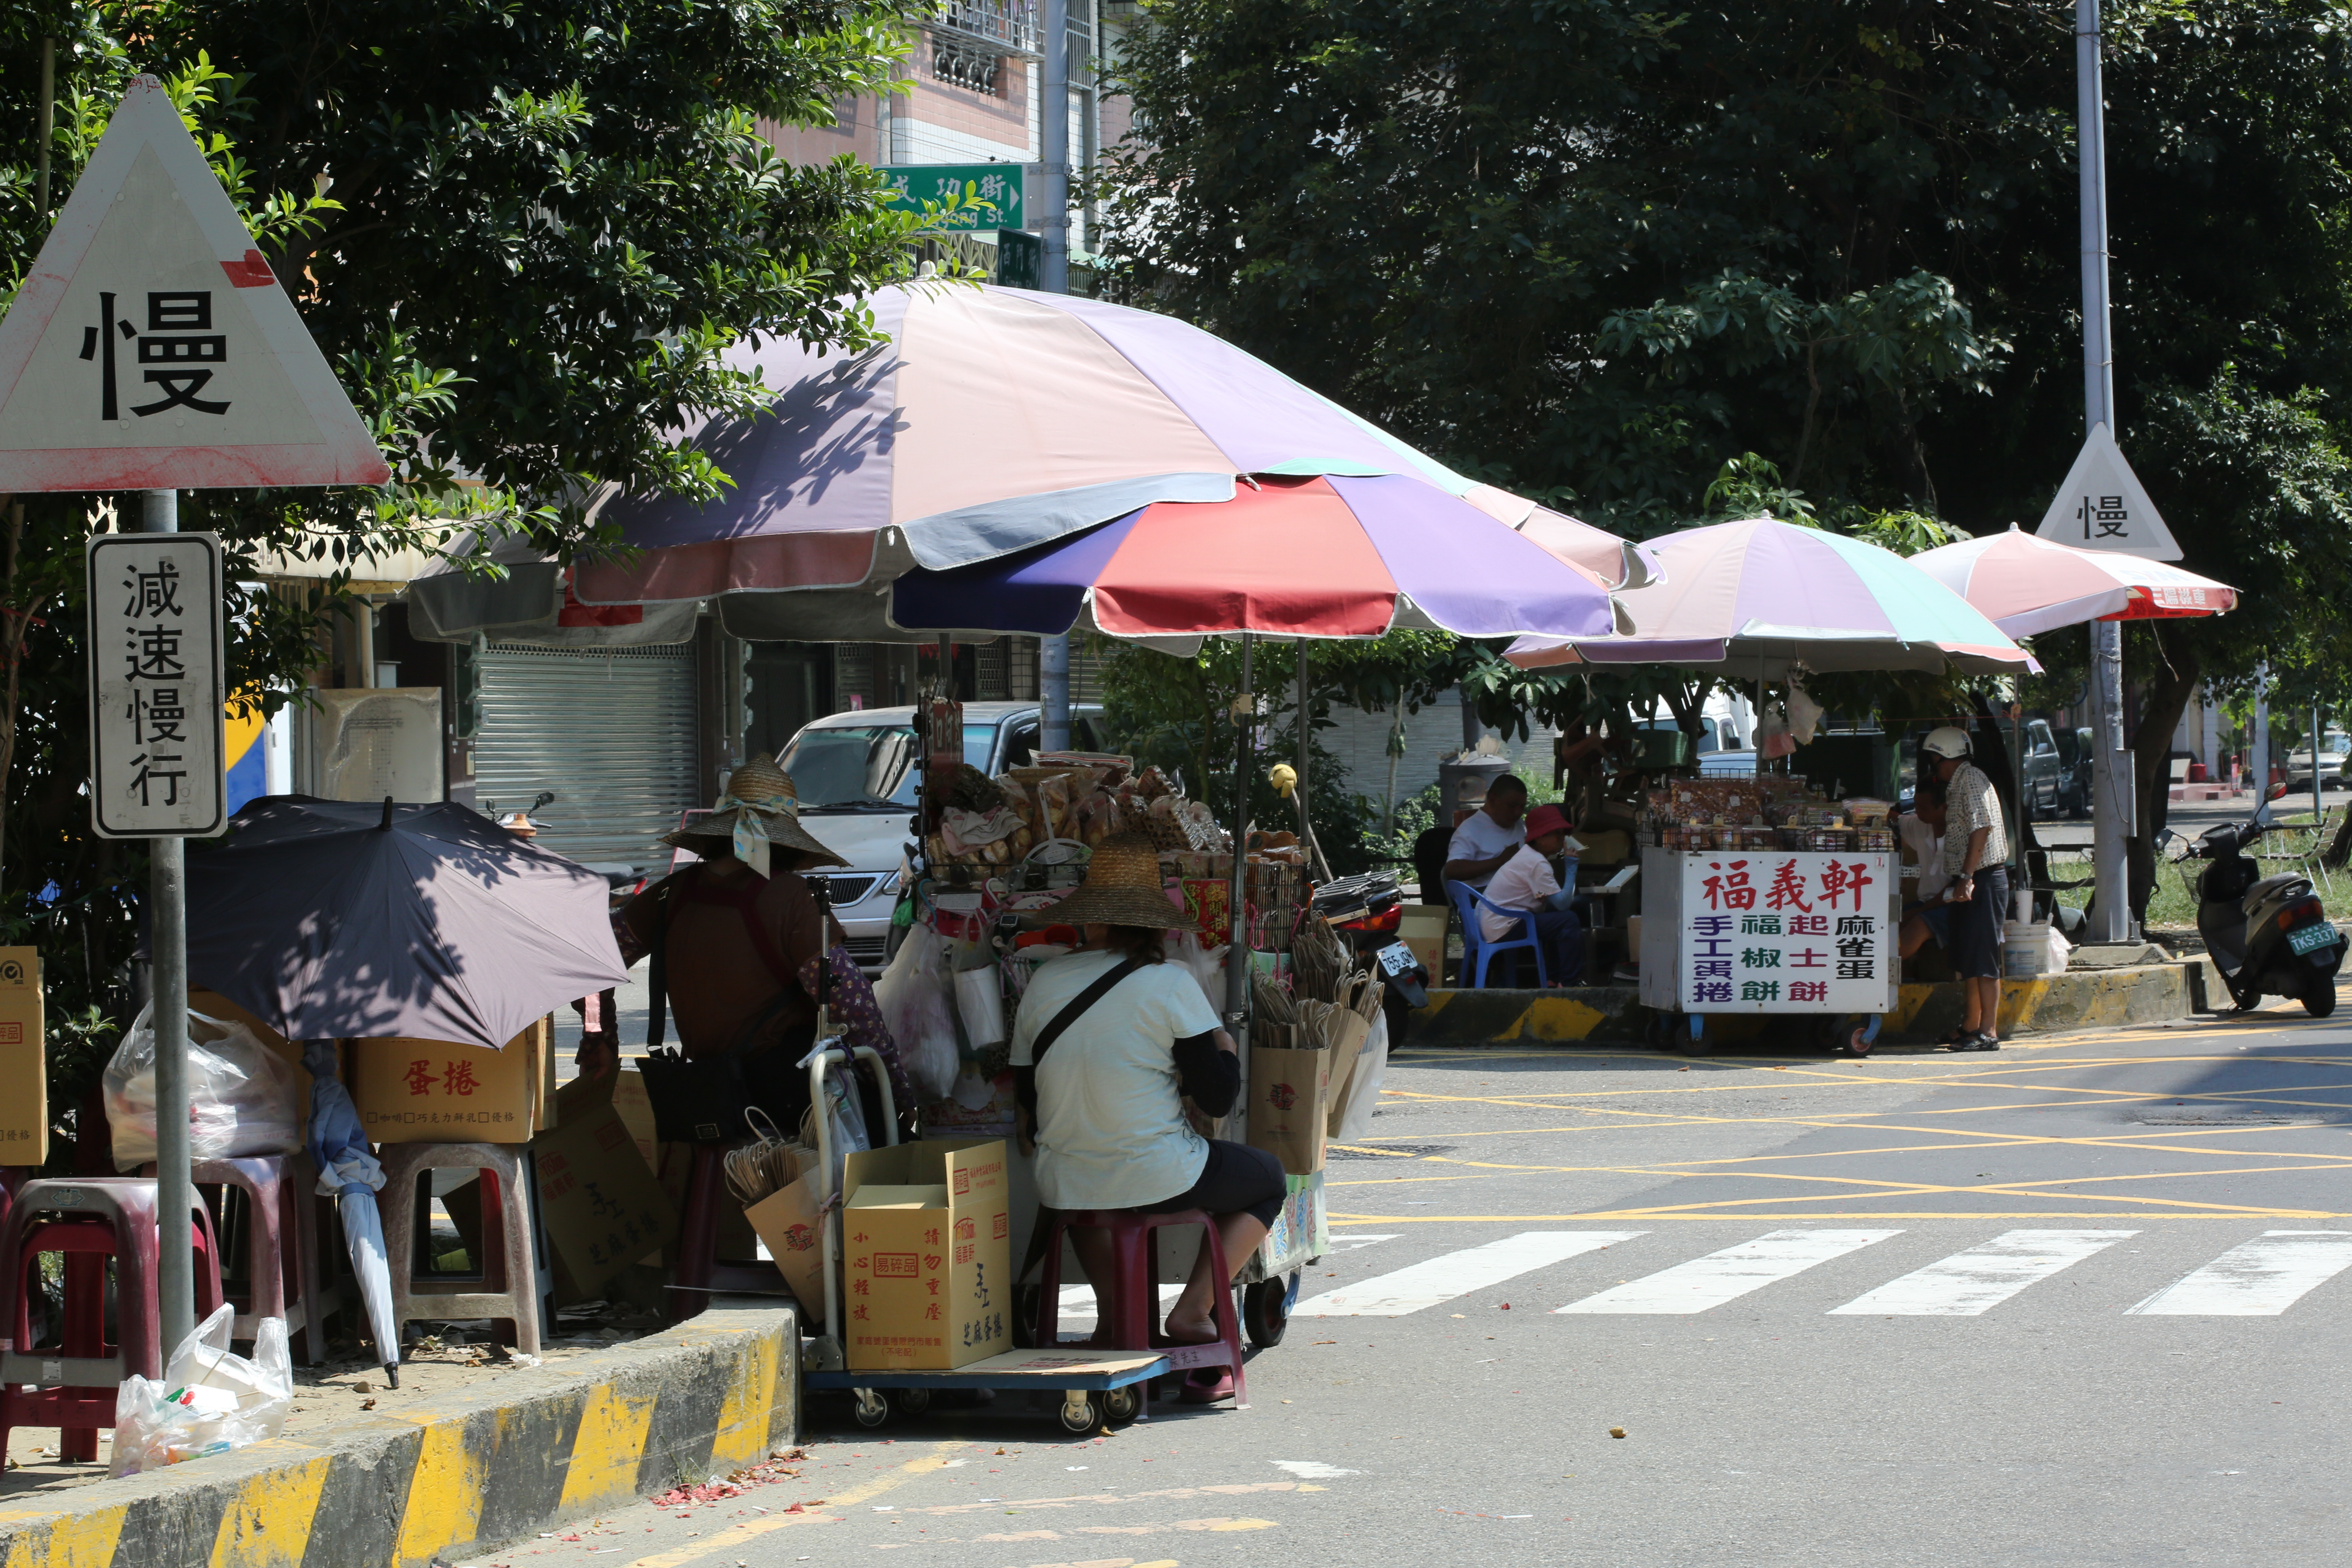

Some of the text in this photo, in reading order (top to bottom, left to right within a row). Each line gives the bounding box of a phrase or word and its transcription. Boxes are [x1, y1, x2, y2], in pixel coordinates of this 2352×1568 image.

[892, 174, 1006, 203] 成功街
[987, 208, 1007, 223] St.
[79, 291, 232, 421] 慢
[2077, 496, 2129, 539] 慢
[2119, 569, 2191, 582] SYM
[2150, 587, 2206, 605] 三陽機車
[122, 561, 187, 806] 減速慢行
[1702, 859, 1873, 913] 福義軒
[1835, 915, 1875, 979] 麻雀蛋
[2291, 928, 2336, 951] TKS-337
[1429, 950, 1437, 988] 請勿重
[1693, 915, 1733, 1002] 手工蛋捲
[1740, 915, 1781, 1002] 福椒餅
[1788, 915, 1828, 1002] 起士餅
[402, 1059, 481, 1096] 蛋捲
[7, 1129, 30, 1140] 優格
[379, 1113, 402, 1123] 咖啡
[491, 1112, 515, 1123] 優格
[853, 1232, 870, 1321] 小心輕放
[877, 1258, 916, 1273] 易碎品
[924, 1229, 942, 1320] 請勿重壓
[856, 1337, 942, 1347] 家庭號蛋捲限門市販售
[964, 1312, 1002, 1347] 芝麻蛋捲
